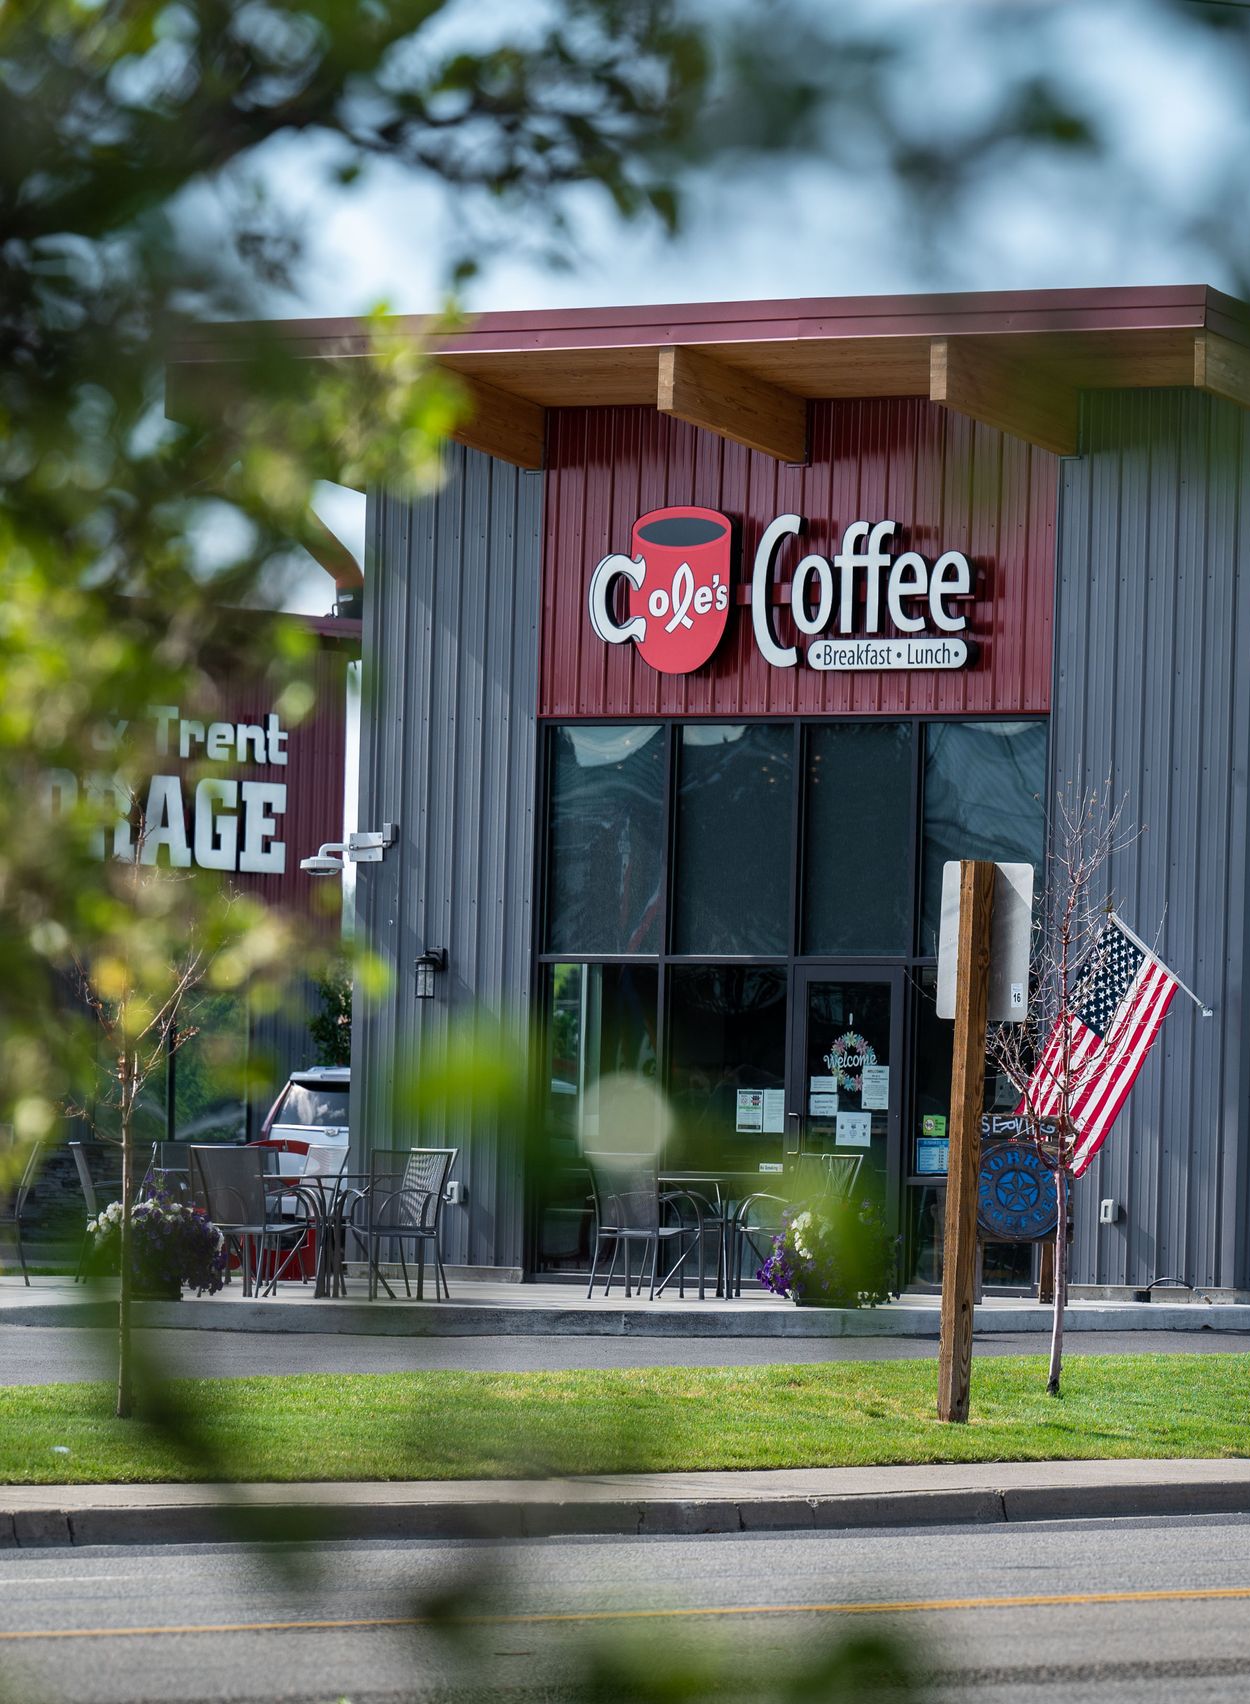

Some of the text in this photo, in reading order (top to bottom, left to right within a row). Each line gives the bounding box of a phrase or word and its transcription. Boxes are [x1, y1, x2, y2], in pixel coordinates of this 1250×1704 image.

[588, 512, 976, 669] Cole's Coffee
[822, 641, 951, 667] Breakfast Lunch
[147, 704, 289, 766] Trent
[1013, 992, 1021, 1003] 16
[822, 1050, 878, 1070] Welcome
